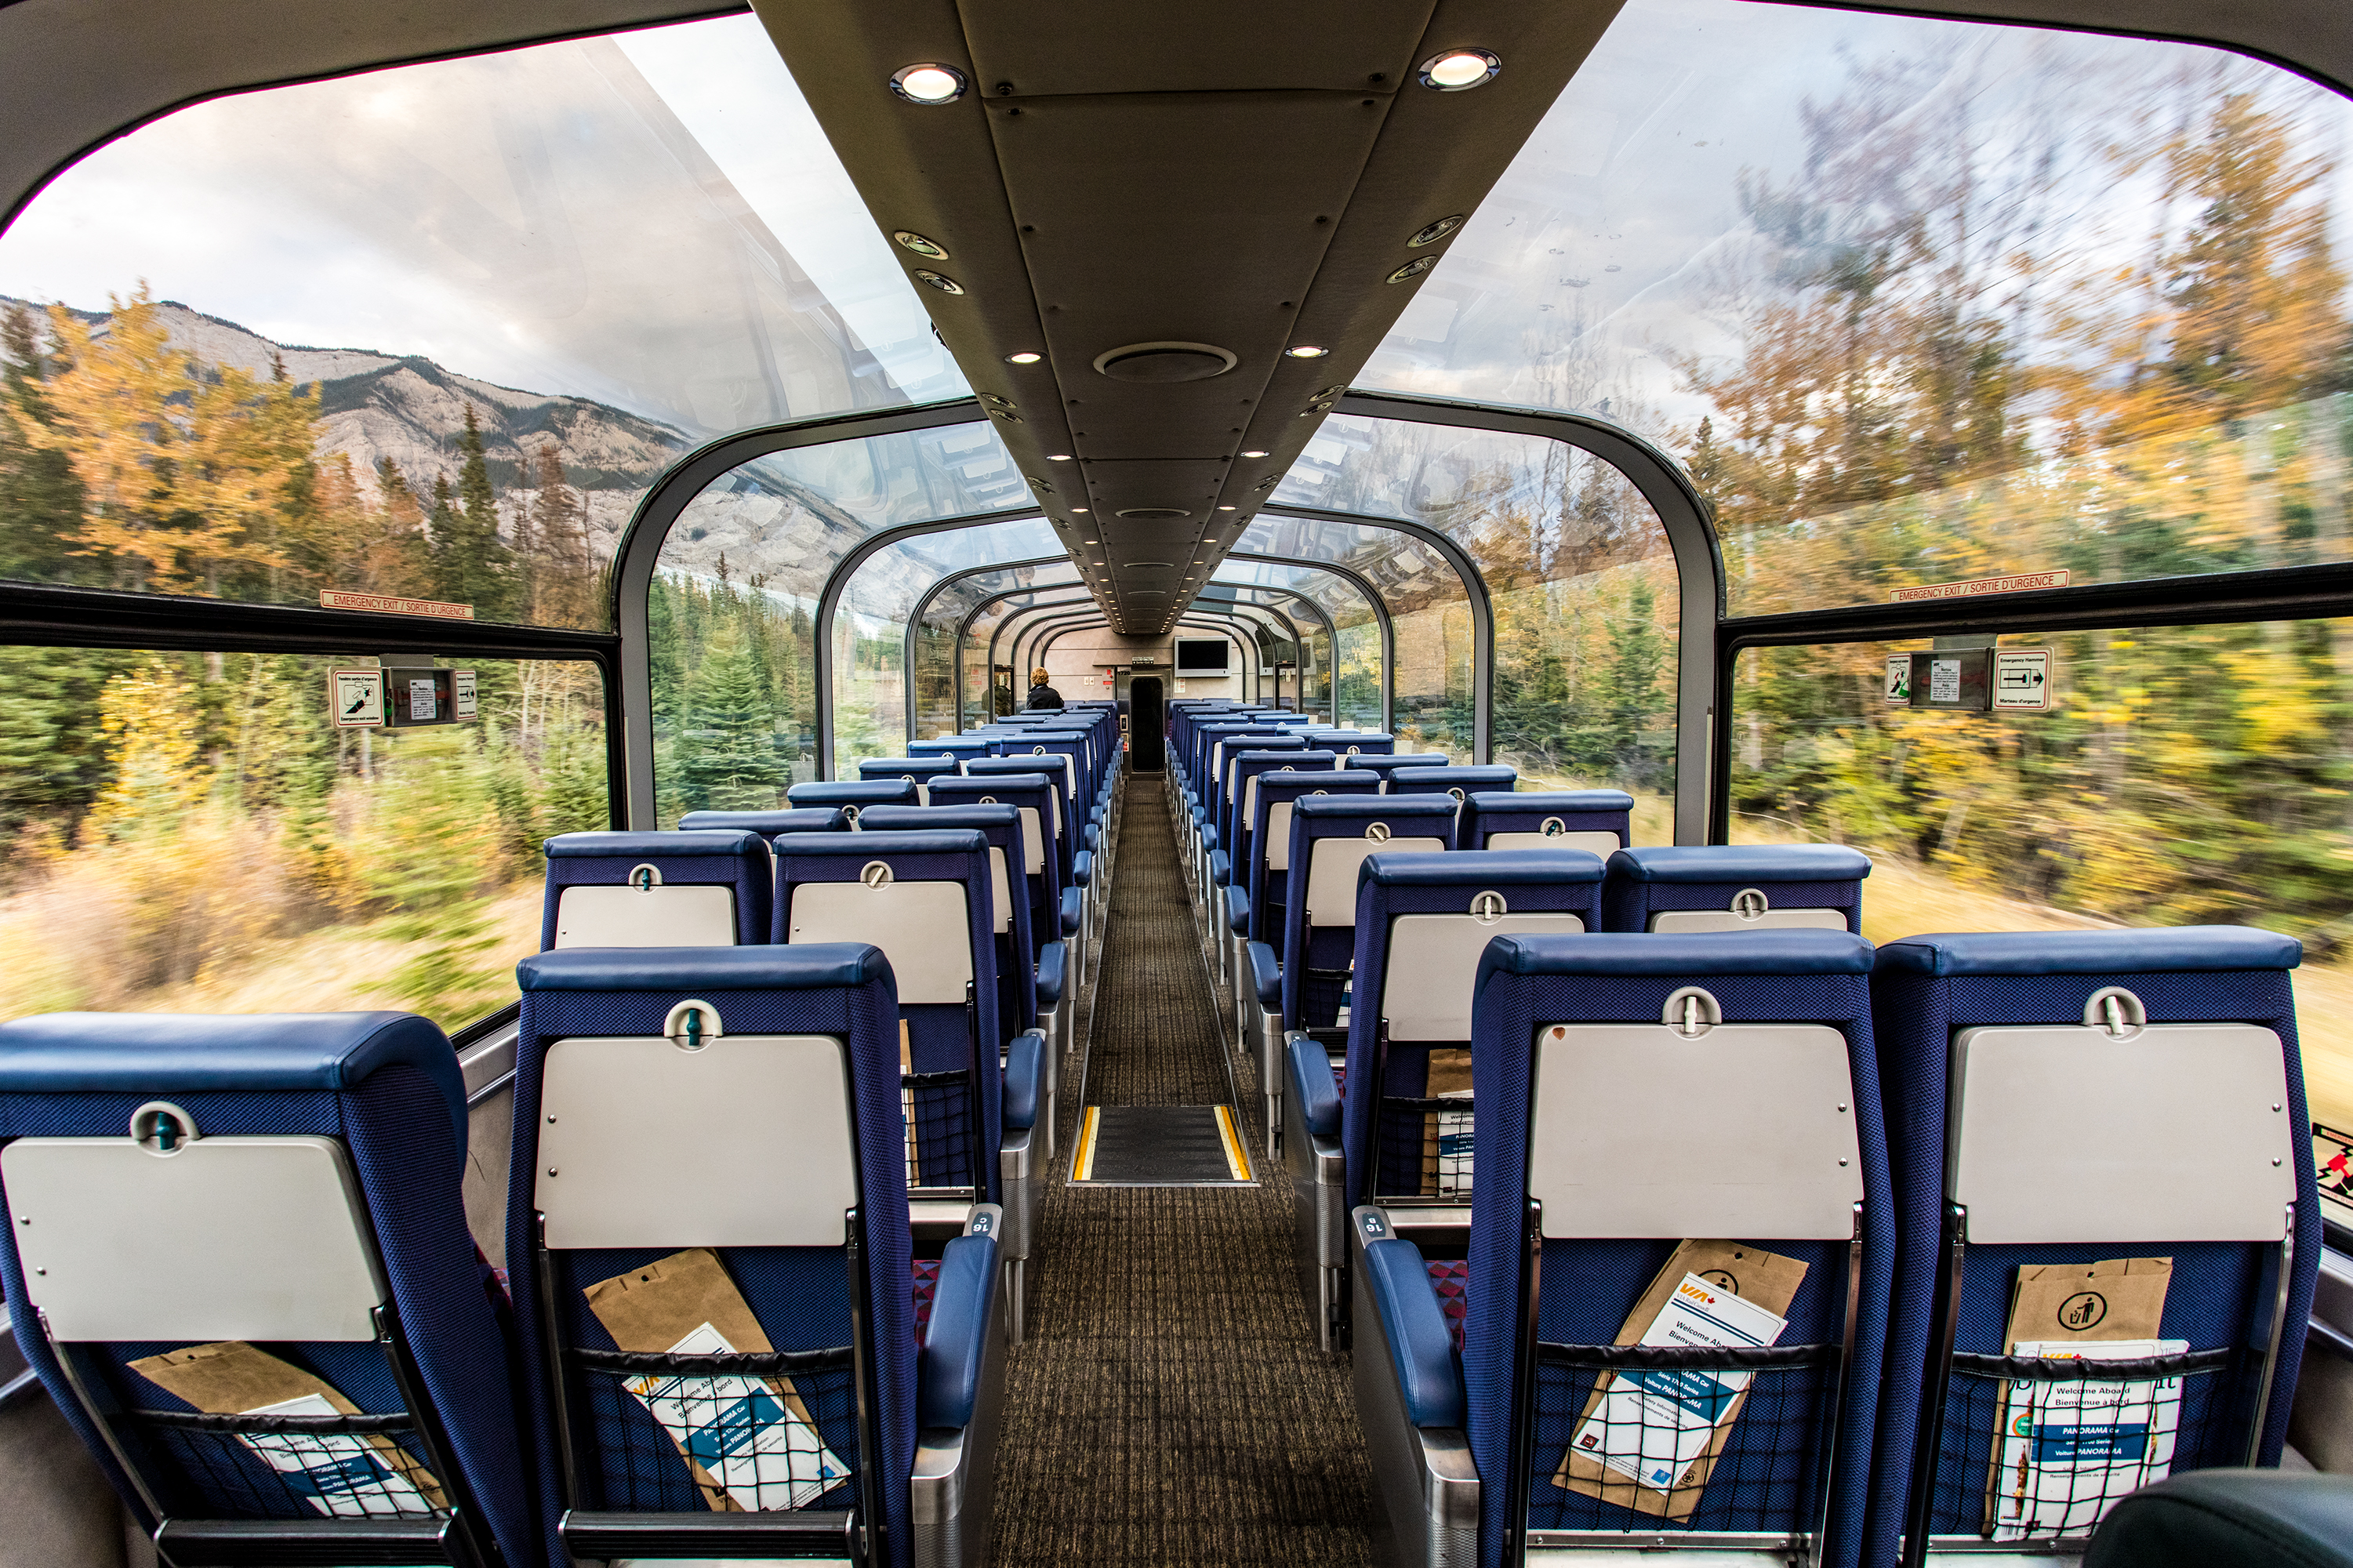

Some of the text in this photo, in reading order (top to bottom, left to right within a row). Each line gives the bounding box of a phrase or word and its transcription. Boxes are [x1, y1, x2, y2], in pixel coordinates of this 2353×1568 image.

[1899, 588, 1943, 601] EMERGENCY
[1944, 586, 1962, 596] EXIT
[1970, 582, 1999, 593] SORTIE
[2002, 575, 2054, 590] D'URGENCE
[333, 595, 381, 608] EMERGENCY
[383, 601, 398, 610] EXIT
[406, 602, 430, 613] SORTIE
[431, 605, 466, 616] D'URGENCE
[2326, 1131, 2353, 1145] EMERGEN
[2320, 1188, 2339, 1199] SORTIE
[1679, 1283, 1708, 1302] VIA
[1676, 1320, 1727, 1347] Welcome Abo
[716, 1378, 732, 1392] bord
[1645, 1377, 1661, 1389] Voiture
[1658, 1371, 1671, 1381] Série
[1684, 1385, 1699, 1396] Series
[1700, 1379, 1709, 1388] Car
